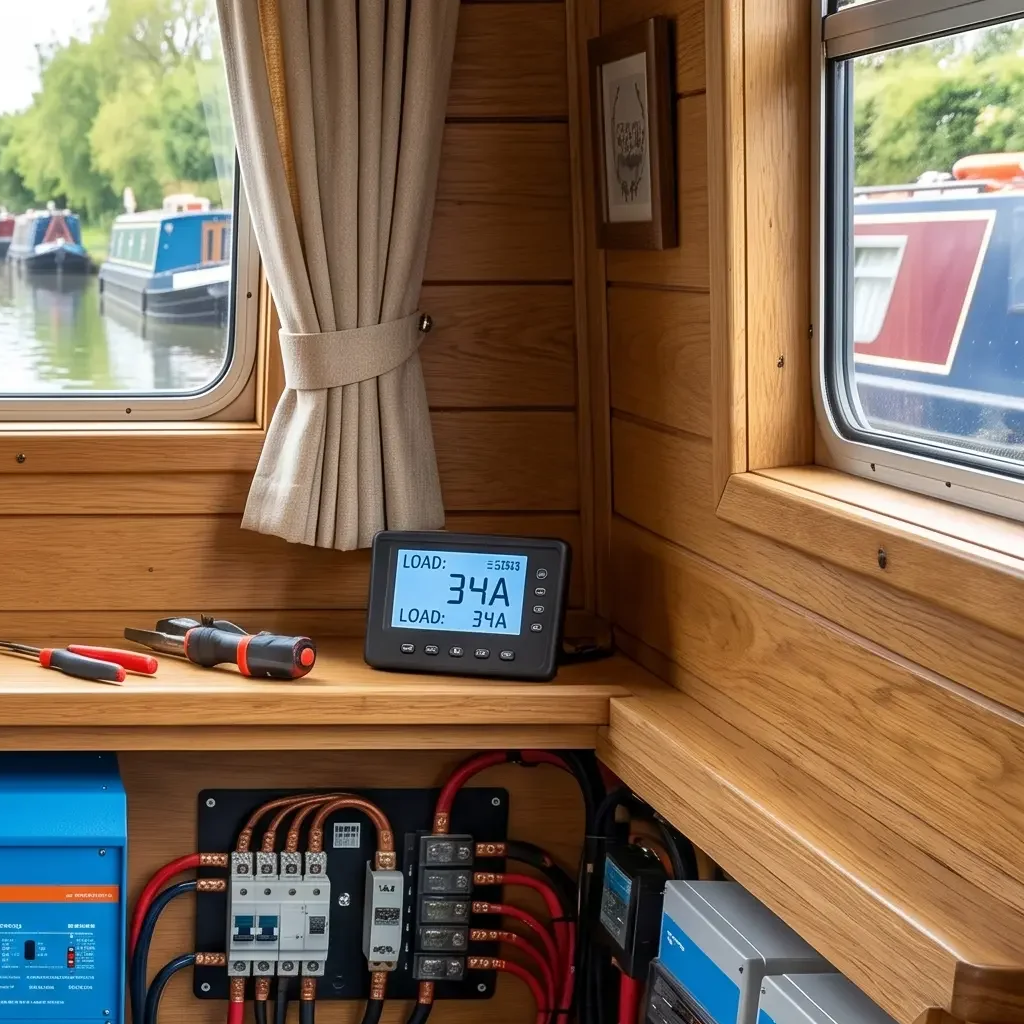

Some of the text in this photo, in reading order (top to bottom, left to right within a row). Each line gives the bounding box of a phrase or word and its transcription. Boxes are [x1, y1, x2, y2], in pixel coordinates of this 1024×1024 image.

[403, 554, 447, 570] LOAD:
[447, 573, 510, 607] 34A
[399, 608, 507, 629] LOAD: 34A
